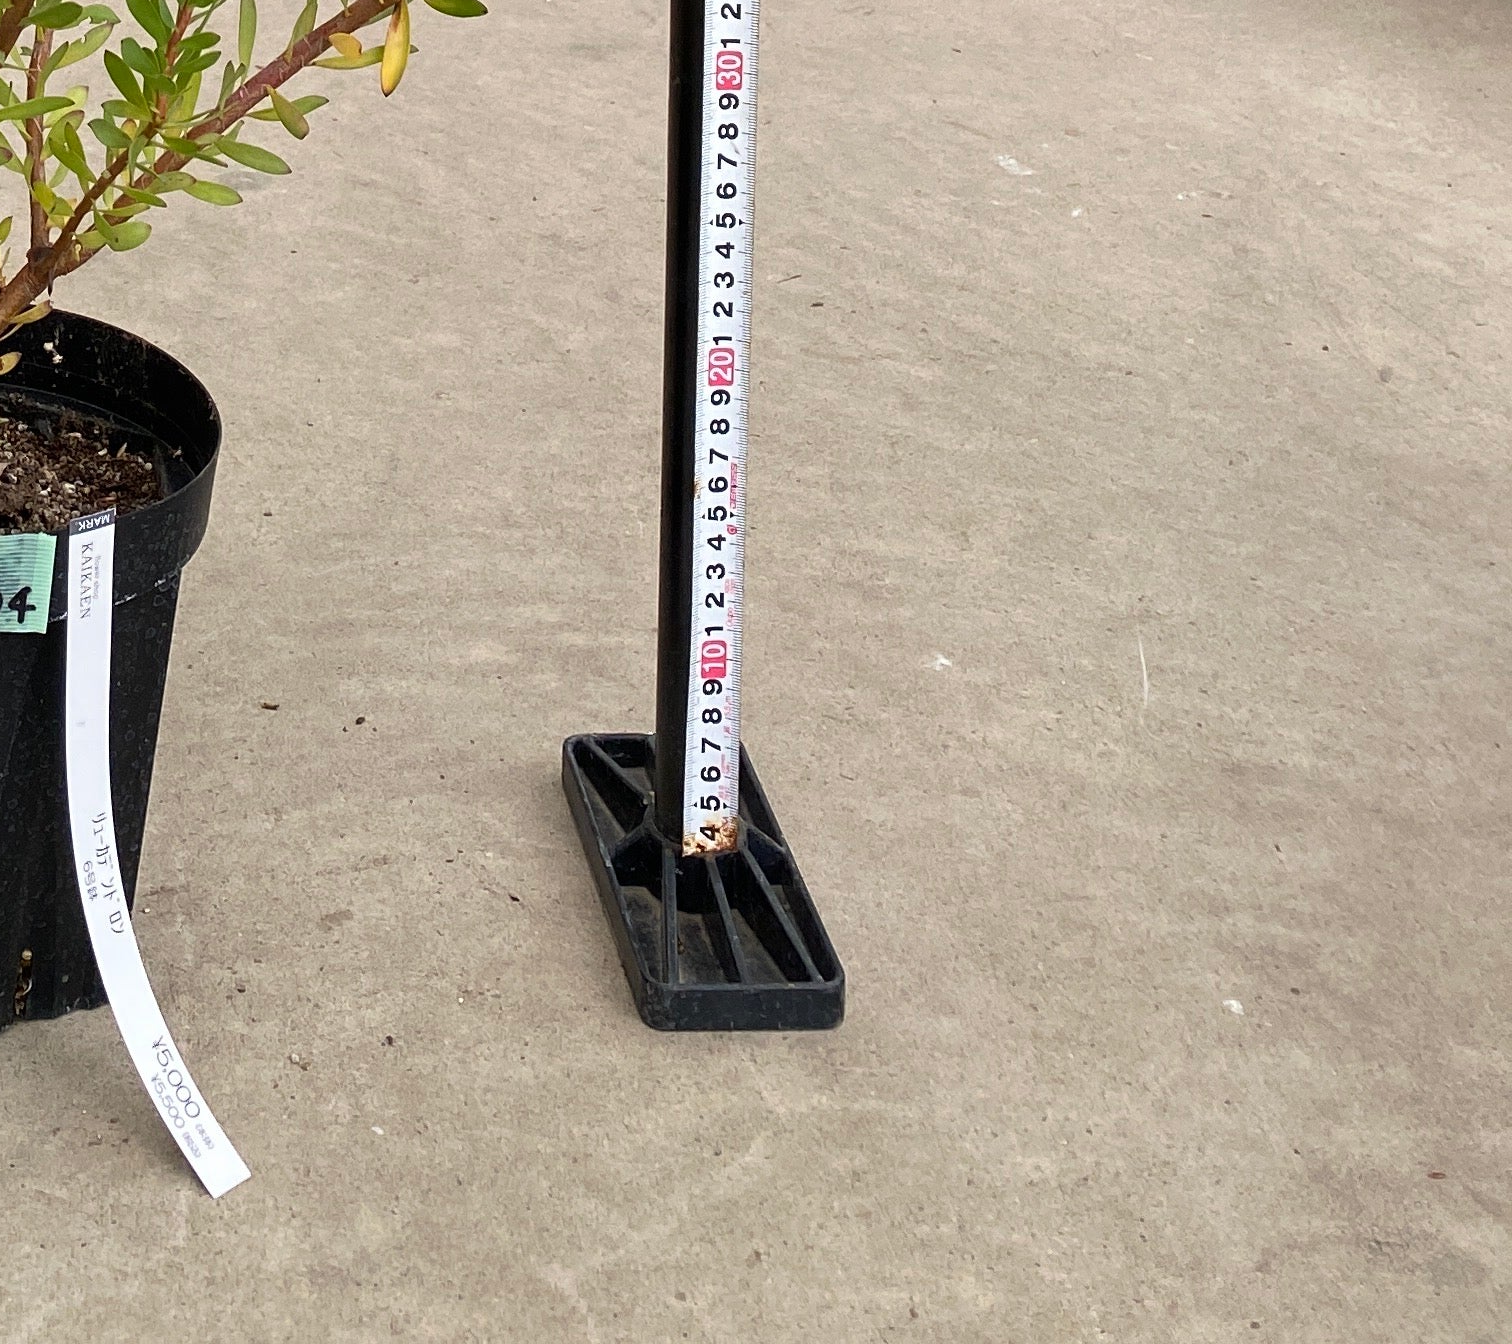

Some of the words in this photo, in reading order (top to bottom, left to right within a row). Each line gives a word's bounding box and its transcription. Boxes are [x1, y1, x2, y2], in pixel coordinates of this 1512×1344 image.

[720, 3, 742, 20] 2
[720, 38, 741, 49] 1
[717, 55, 741, 85] 30
[718, 92, 740, 110] 9
[717, 122, 739, 140] 8
[717, 153, 738, 170] 7
[716, 182, 737, 200] 6
[715, 212, 737, 229] 5
[714, 241, 735, 259] 4
[713, 271, 735, 289] 3
[712, 301, 734, 318] 2
[712, 336, 733, 346] 1
[710, 352, 733, 381] 20
[710, 389, 731, 406] 9
[709, 418, 730, 435] 8
[708, 448, 729, 465] 7
[708, 476, 729, 493] 6
[707, 505, 728, 522] 5
[77, 513, 111, 532] MARK
[706, 534, 727, 551] 4
[705, 563, 726, 580] 3
[79, 541, 94, 620] KAIKAEN
[704, 592, 725, 609] 2
[704, 626, 724, 637] 1
[702, 644, 726, 672] 10
[702, 679, 723, 696] 9
[701, 707, 723, 725] 8
[701, 737, 722, 754] 7
[700, 765, 721, 783] 6
[700, 795, 721, 812] 5
[699, 824, 721, 842] 4
[151, 1034, 201, 1119] ¥5,000
